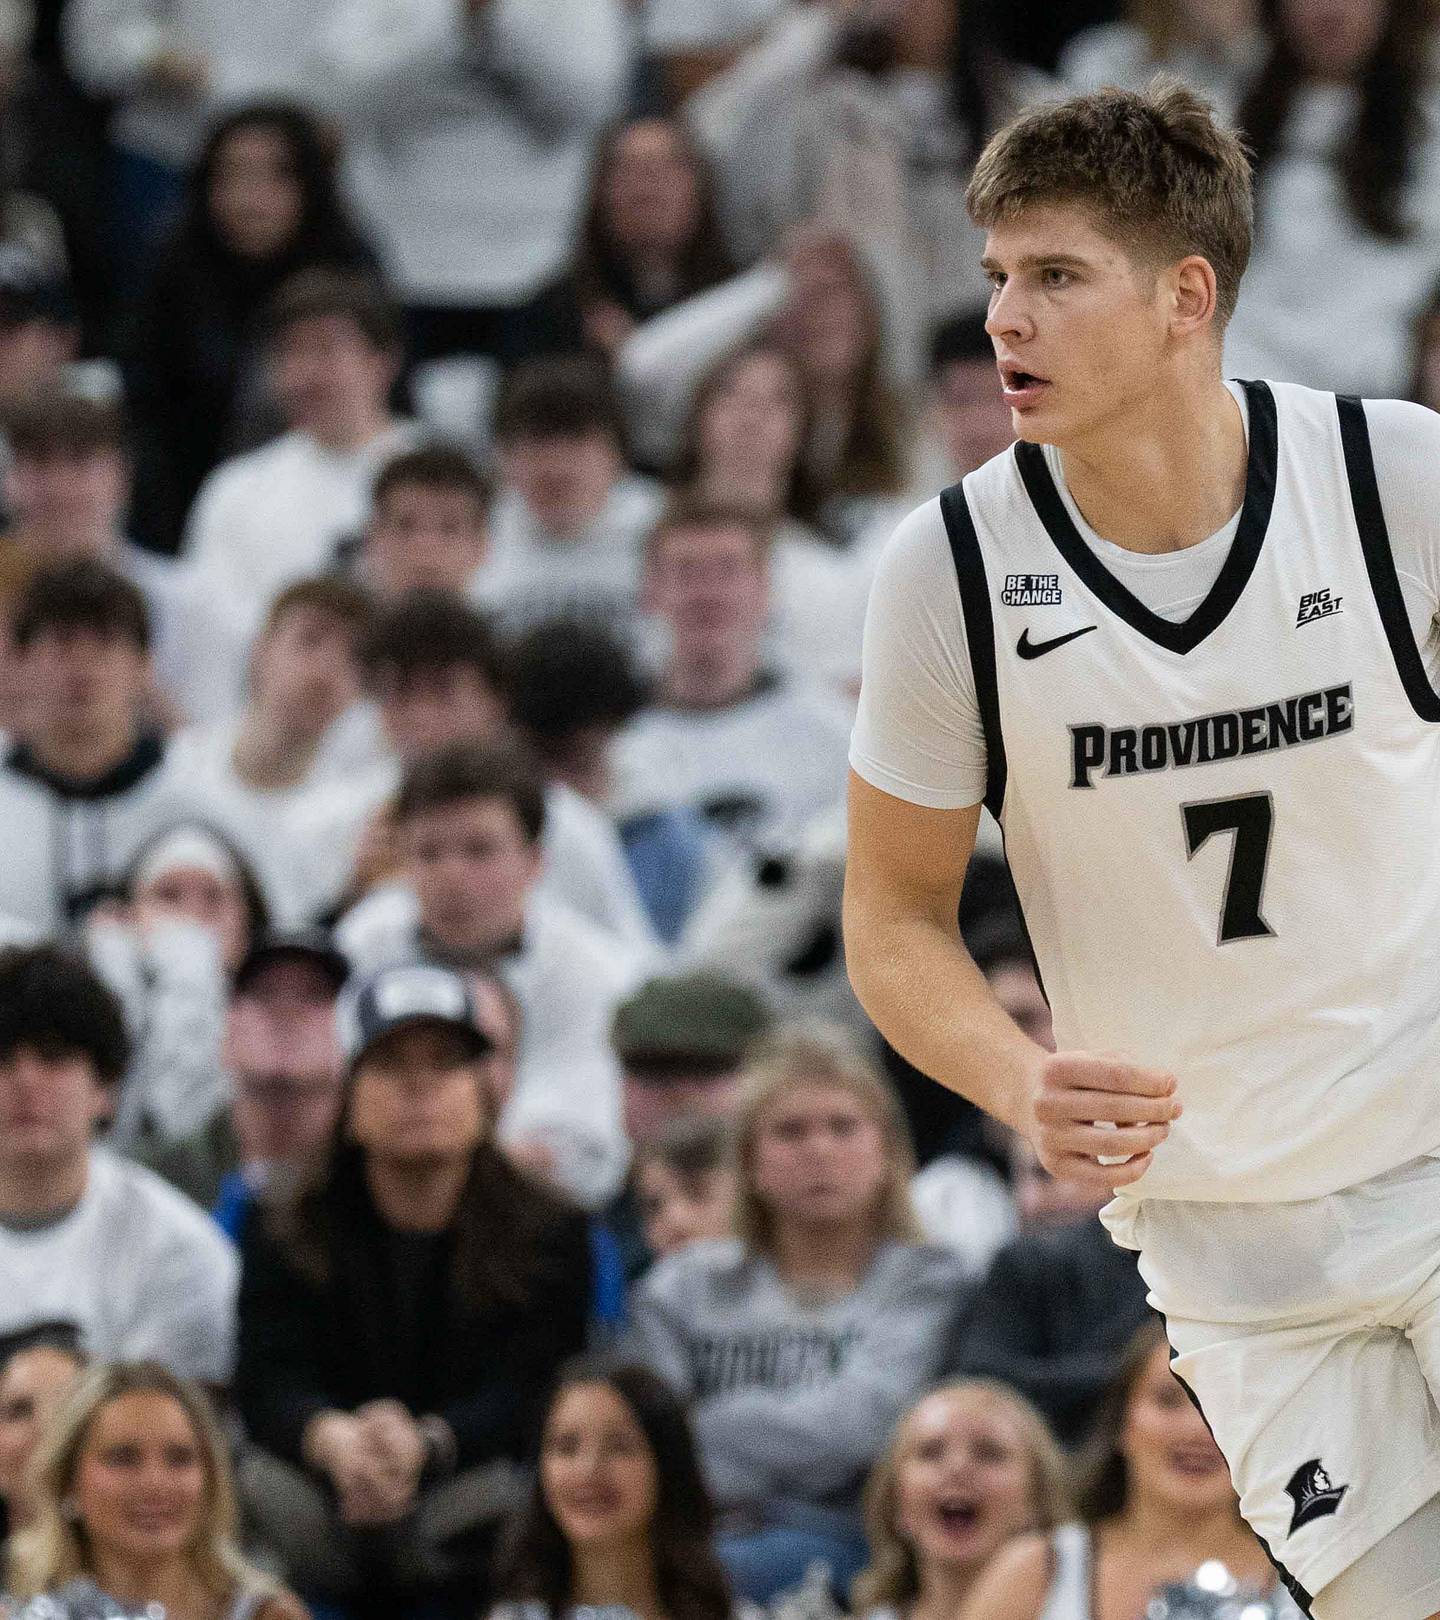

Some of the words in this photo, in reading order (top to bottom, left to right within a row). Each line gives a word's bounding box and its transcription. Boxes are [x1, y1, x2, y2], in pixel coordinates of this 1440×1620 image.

[1006, 575, 1026, 590] BE
[1030, 575, 1057, 589] THE
[1002, 590, 1061, 605] CHANGE
[1300, 588, 1330, 609] BIG
[1297, 597, 1343, 622] EAST
[1066, 681, 1354, 789] PROVIDENCE
[1180, 790, 1279, 946] 7
